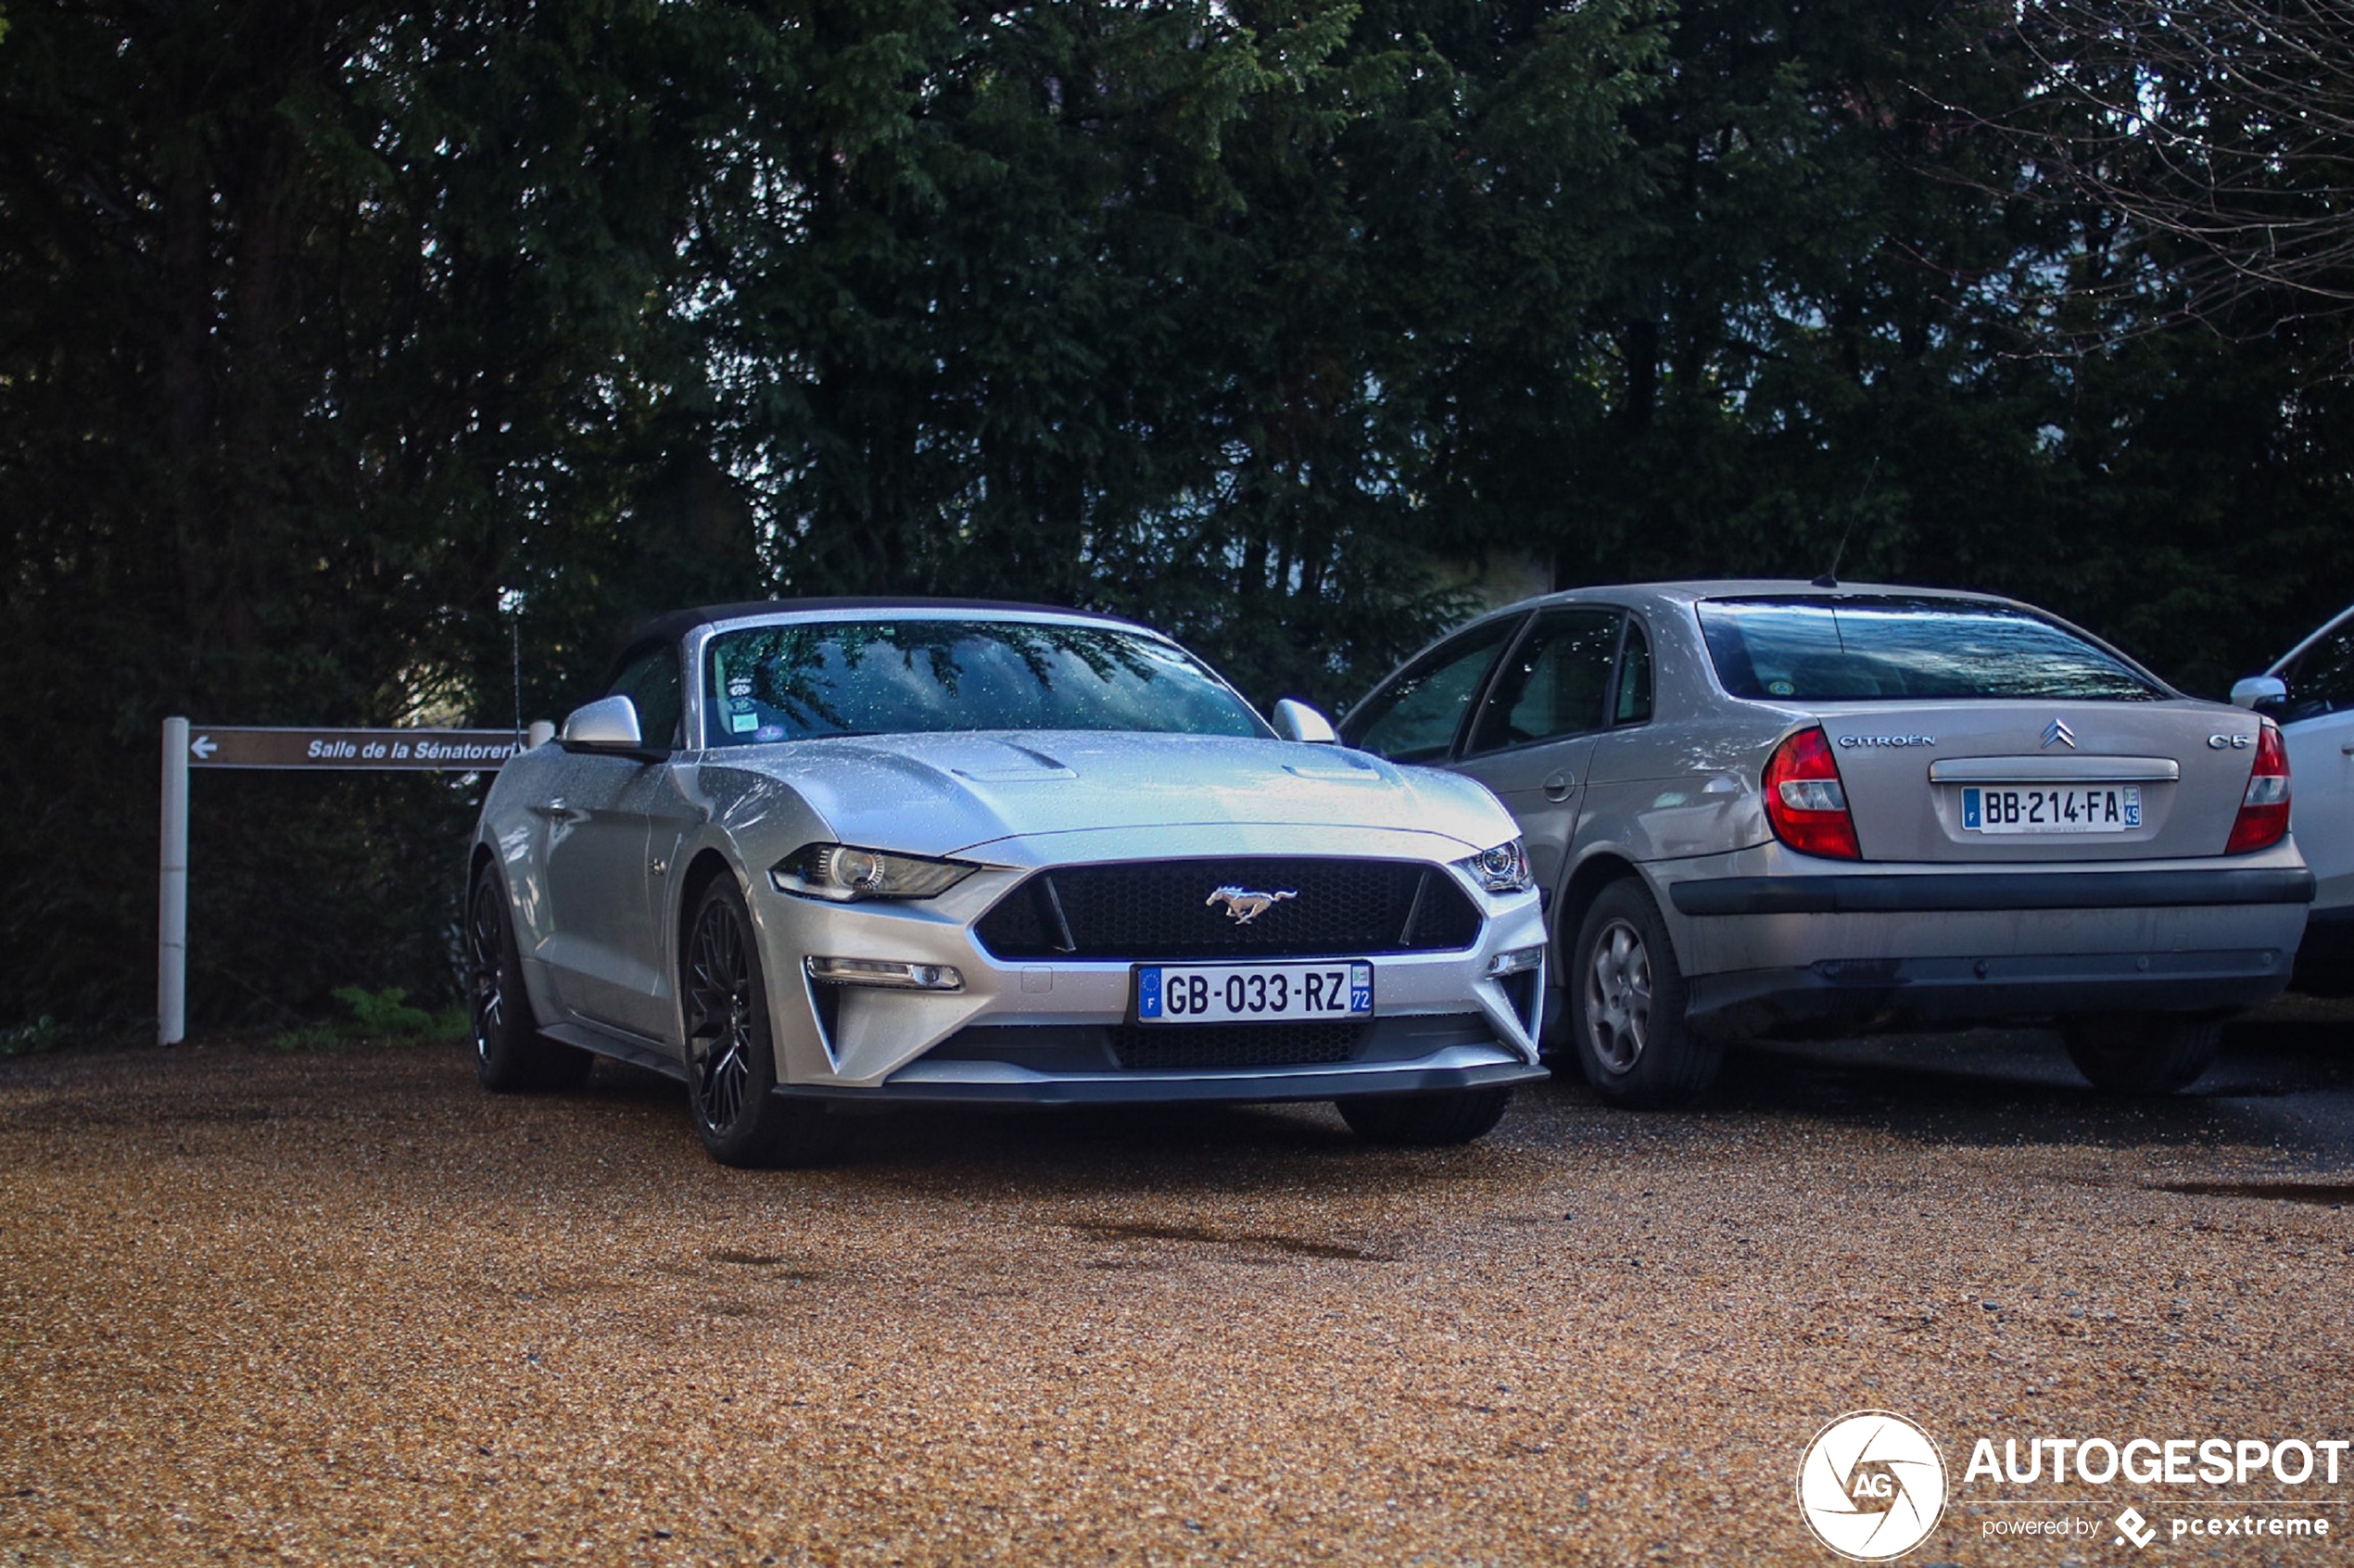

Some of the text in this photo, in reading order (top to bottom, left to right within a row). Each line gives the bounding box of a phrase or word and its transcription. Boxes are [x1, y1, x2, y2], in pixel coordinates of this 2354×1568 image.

[308, 740, 356, 758] Salle
[361, 741, 386, 758] de
[390, 742, 408, 759] la
[1839, 734, 1936, 748] CITROËN
[2208, 734, 2250, 750] C5
[1968, 791, 2139, 824] F BB-214-FA 49
[1147, 972, 1370, 1015] F GB-033-RZ 72
